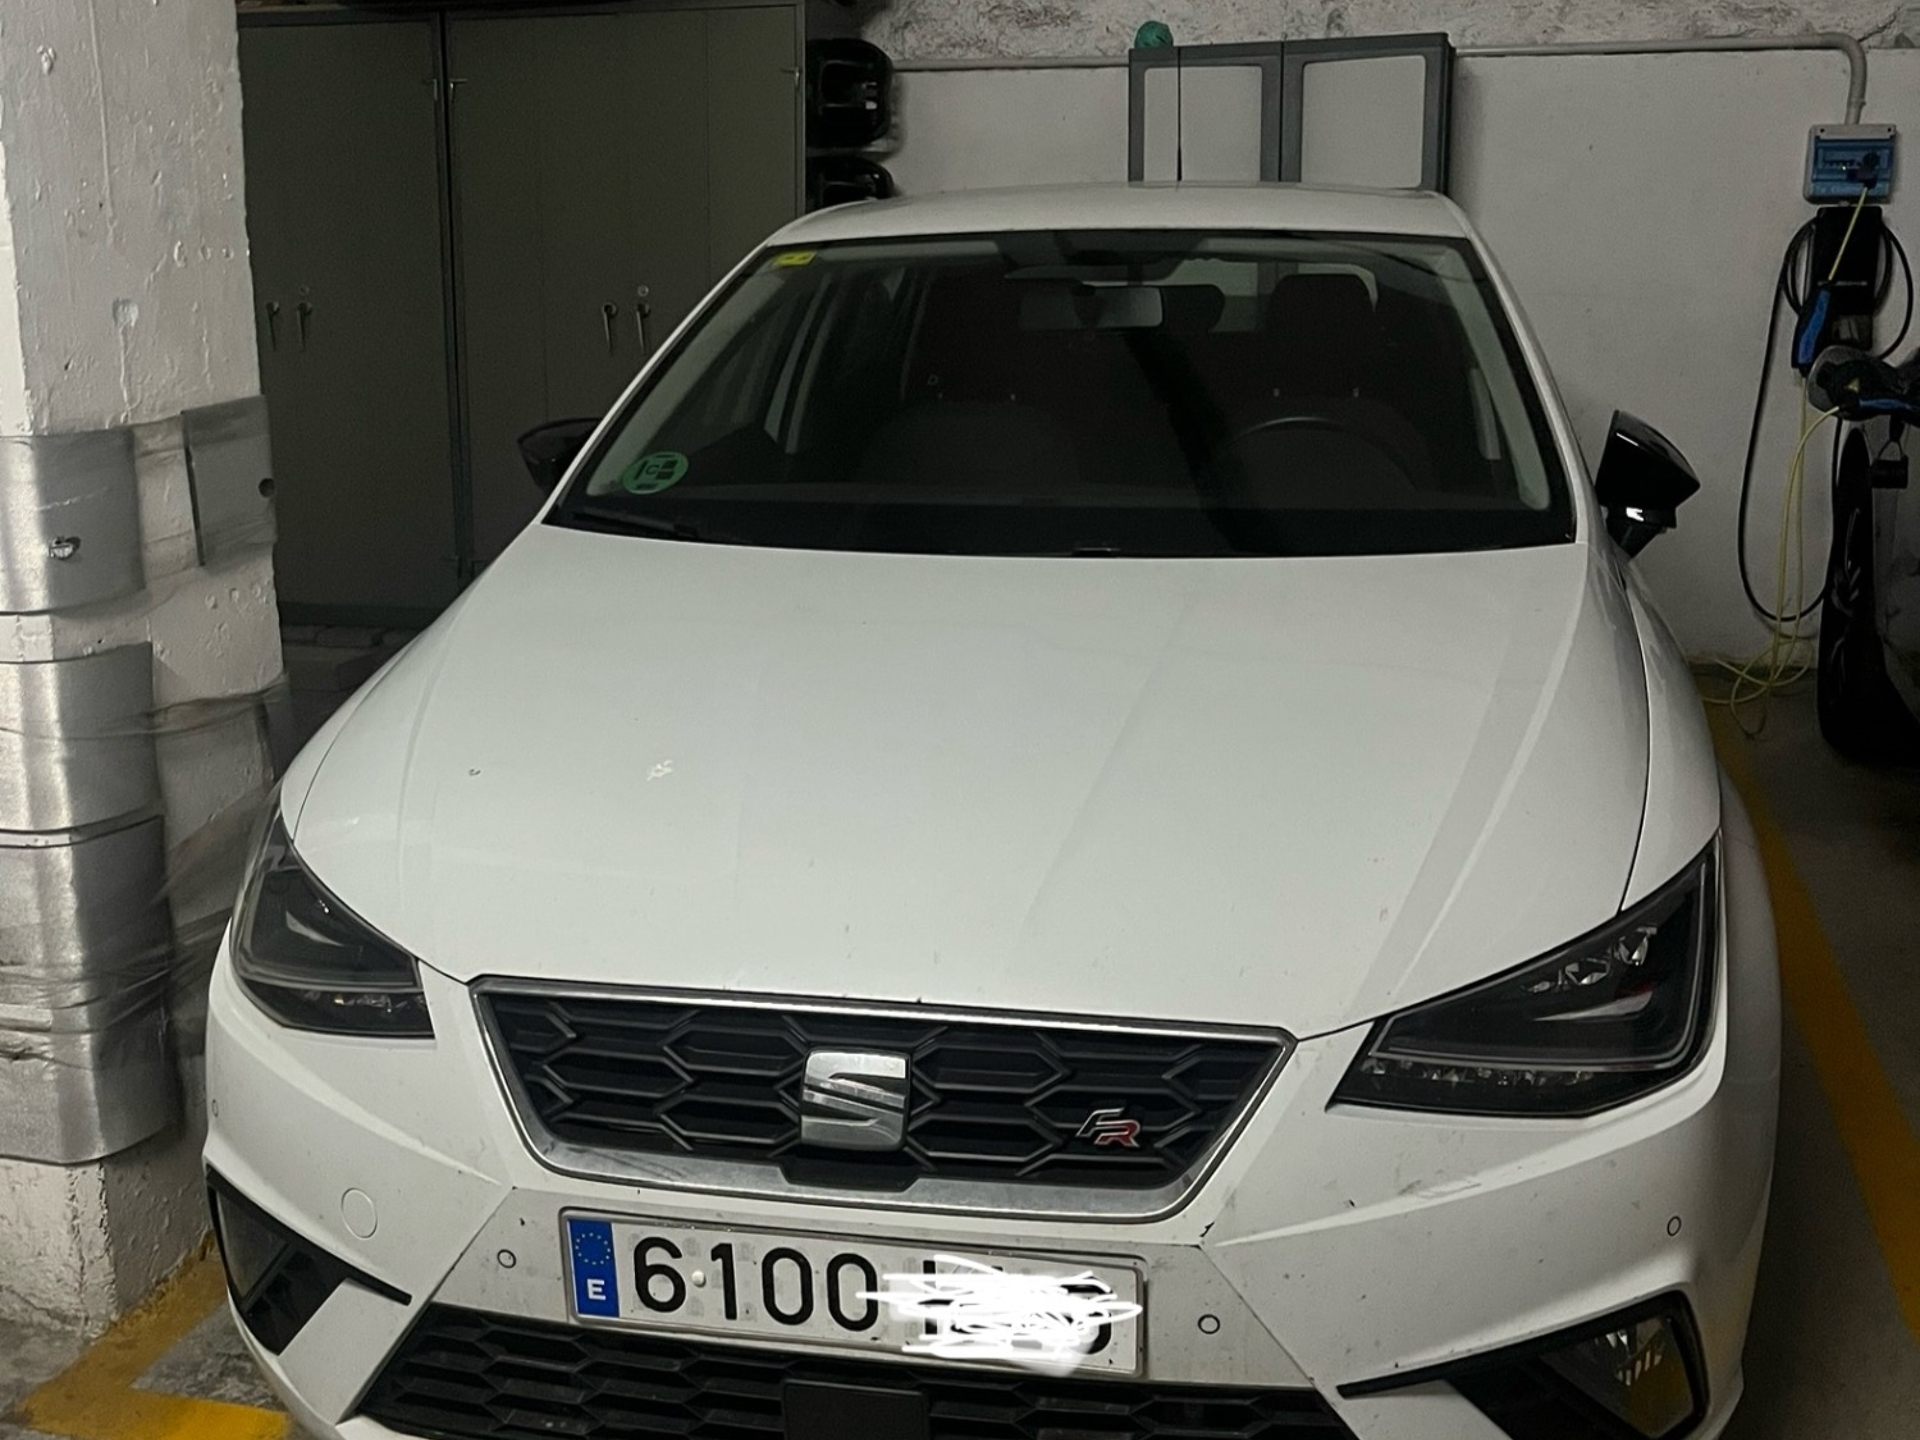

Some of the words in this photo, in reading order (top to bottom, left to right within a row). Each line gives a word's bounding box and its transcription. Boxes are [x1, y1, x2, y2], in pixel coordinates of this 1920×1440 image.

[1075, 1107, 1140, 1148] FR
[586, 1278, 607, 1301] E
[633, 1236, 879, 1332] 6100
